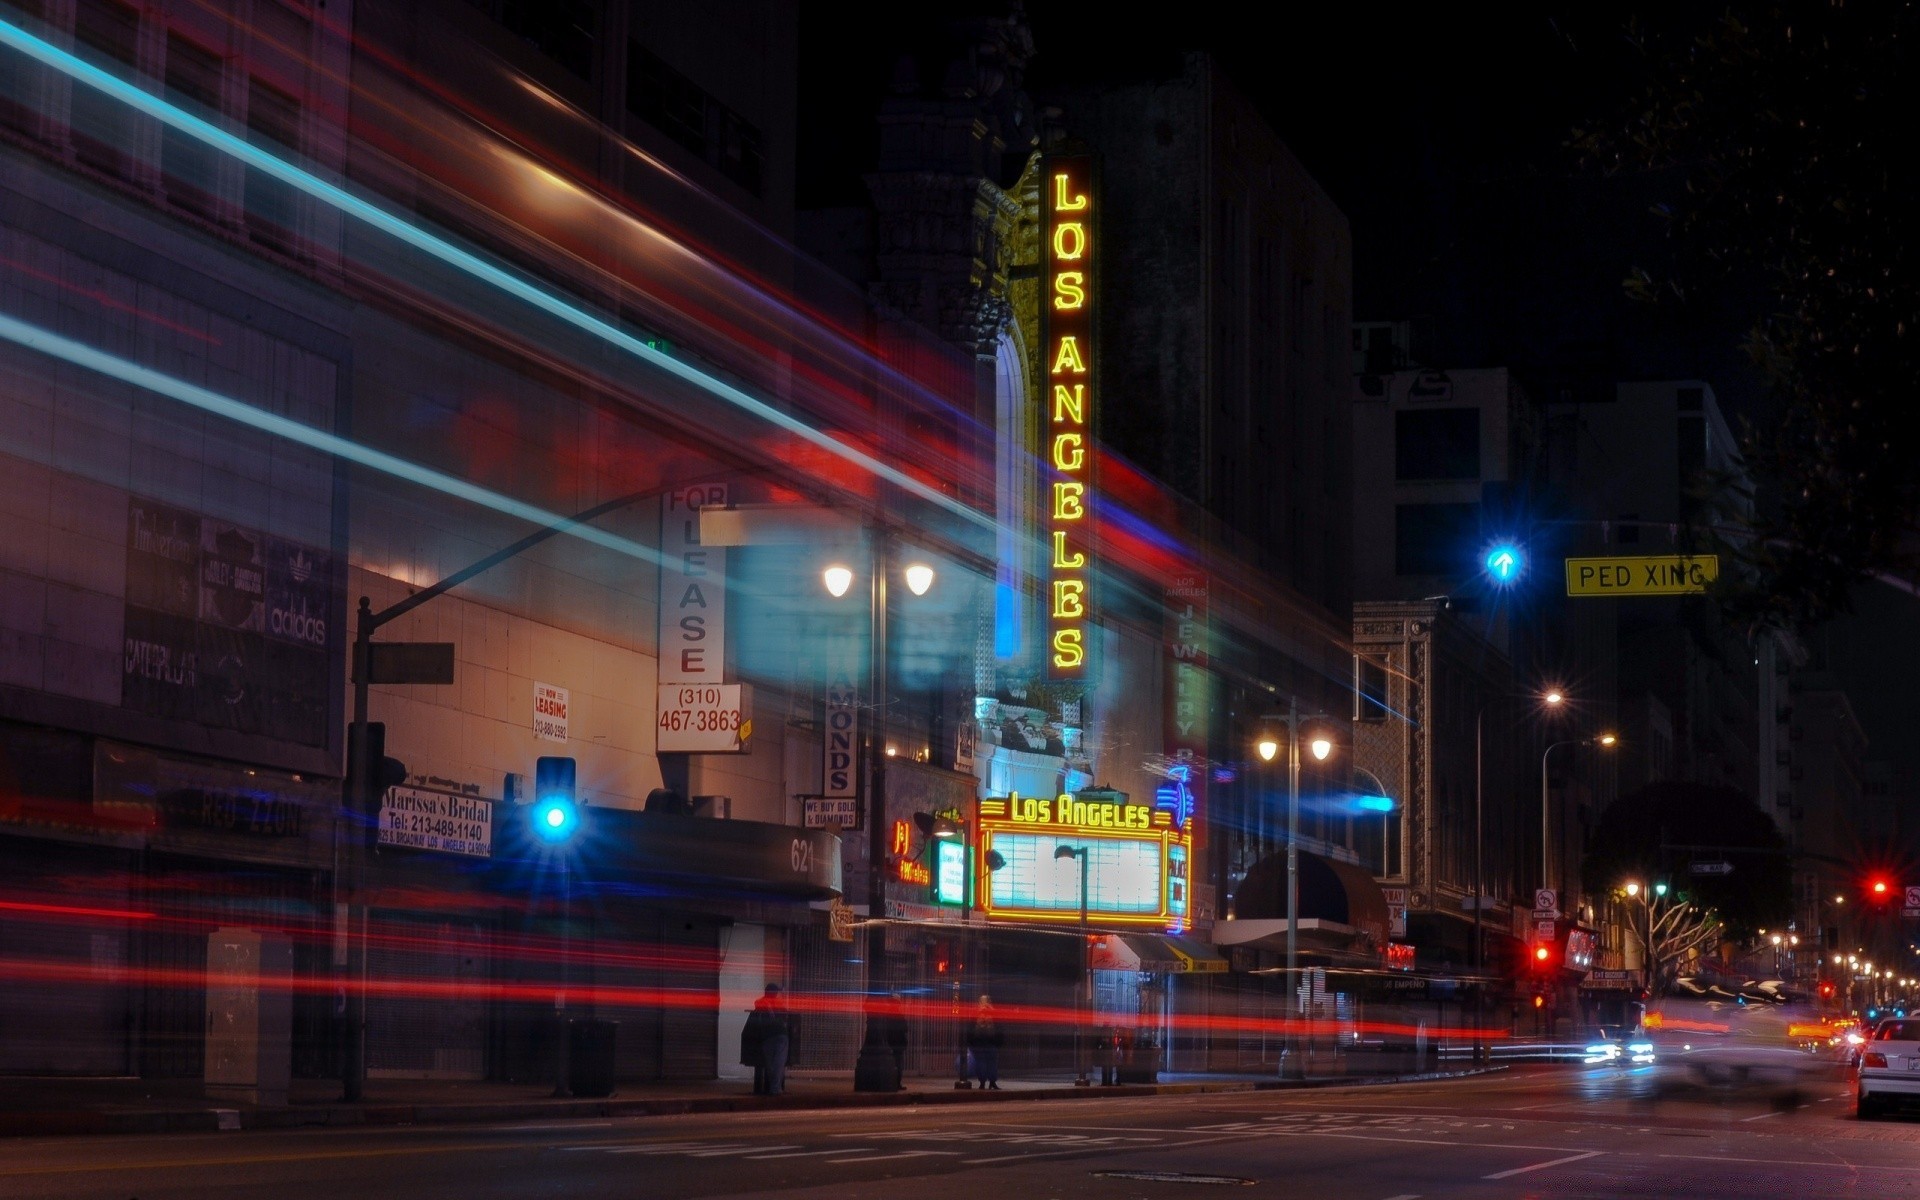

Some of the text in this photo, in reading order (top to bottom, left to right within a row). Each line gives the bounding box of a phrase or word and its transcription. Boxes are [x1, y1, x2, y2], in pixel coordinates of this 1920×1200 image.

[1052, 174, 1087, 667] LOS ANGELES
[669, 487, 726, 512] FOR
[1580, 563, 1705, 588] PED XING
[679, 520, 707, 673] LEASE
[271, 592, 325, 645] adidas
[1172, 604, 1200, 736] JEWELRY
[535, 697, 566, 719] LEASING
[679, 689, 721, 708] (310)
[660, 710, 741, 732] 467-3863
[384, 787, 489, 823] Marissa's Bridal
[806, 802, 855, 813] WE BUY GOLD
[389, 812, 482, 841] Tel: 213-489-1140
[791, 838, 814, 873] 621
